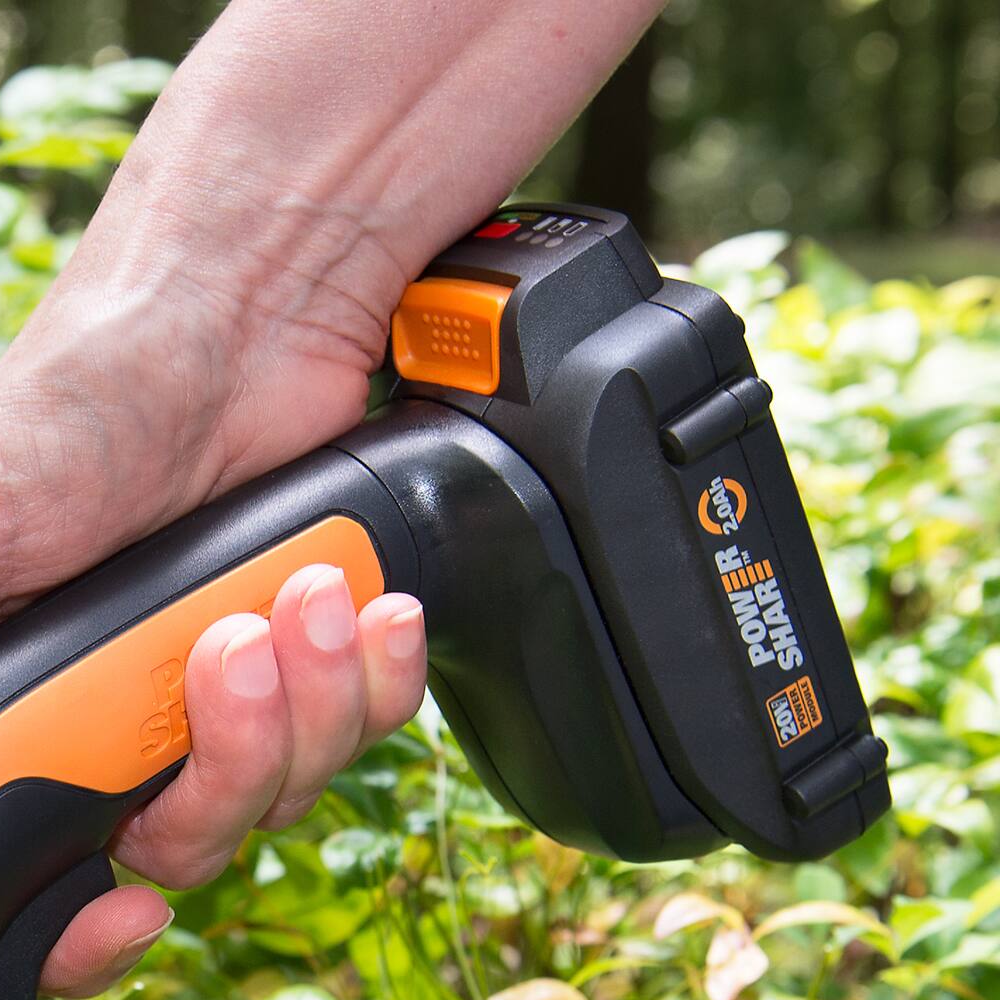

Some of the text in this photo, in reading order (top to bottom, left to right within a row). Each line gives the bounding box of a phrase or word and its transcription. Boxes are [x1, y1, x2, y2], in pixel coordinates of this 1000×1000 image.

[708, 475, 739, 535] 2.0Ah
[714, 544, 776, 667] POWER
[746, 558, 804, 671] SHARE
[789, 688, 808, 730] POWER
[800, 680, 819, 723] MODULE
